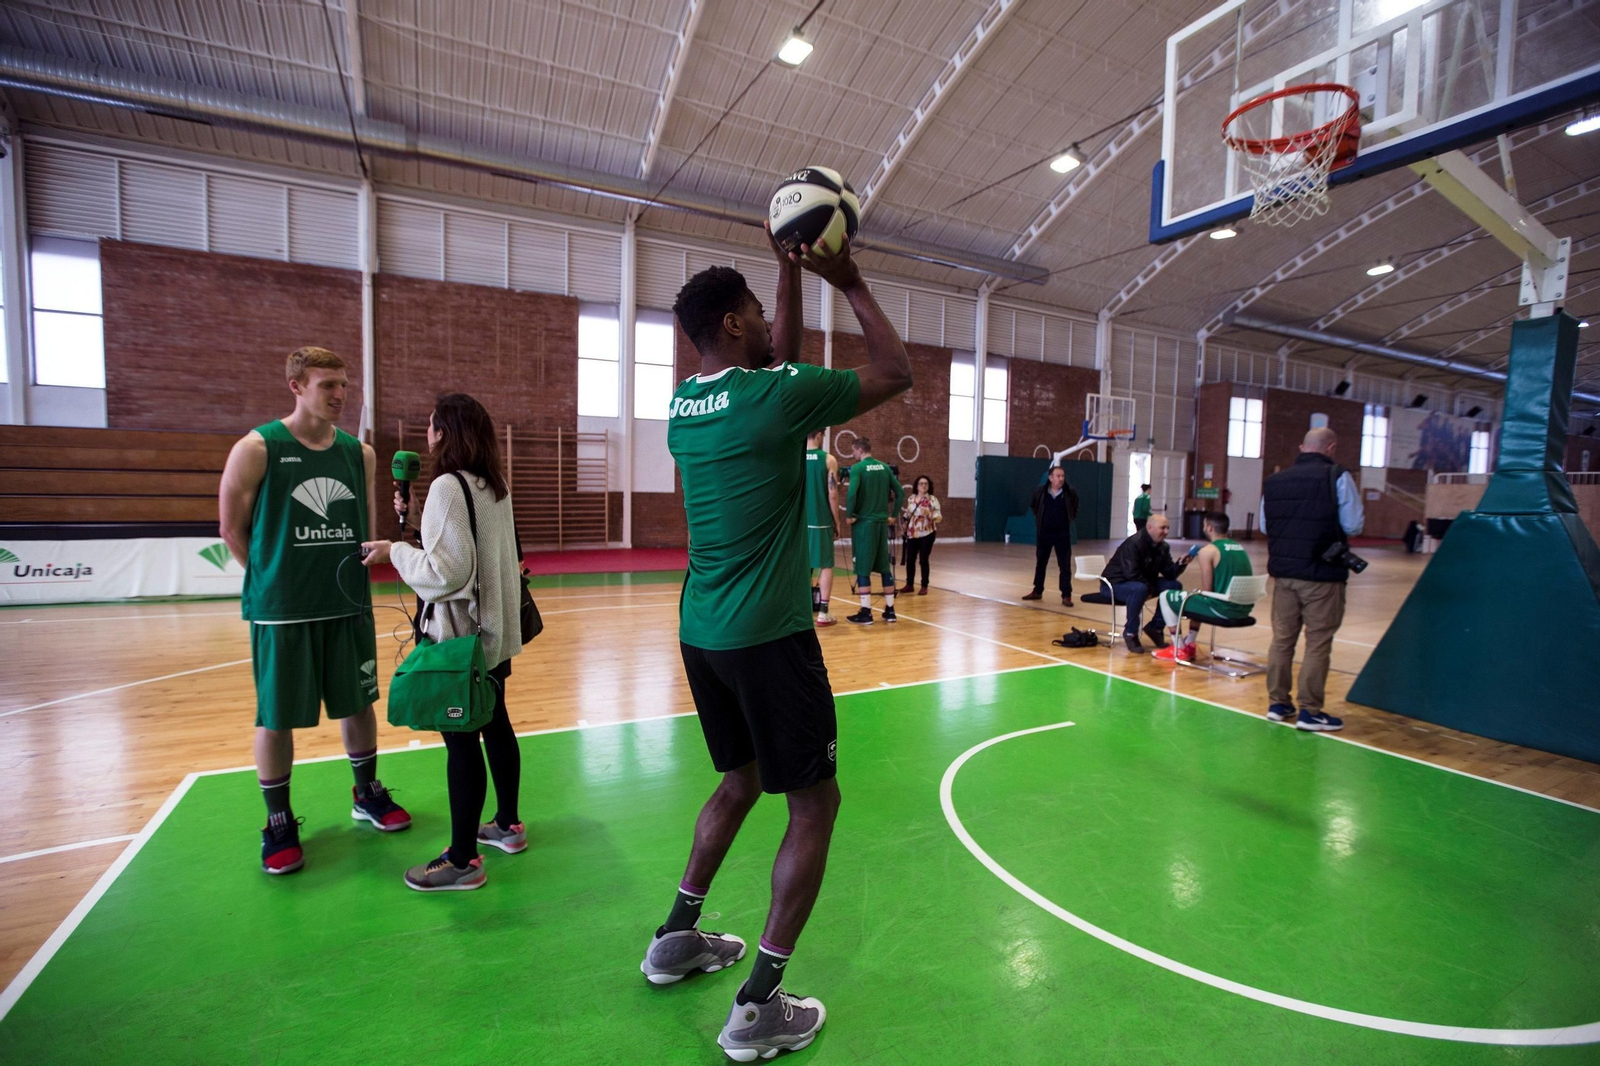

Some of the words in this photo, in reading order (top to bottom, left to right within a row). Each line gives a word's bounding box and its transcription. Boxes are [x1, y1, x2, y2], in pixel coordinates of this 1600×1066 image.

[670, 390, 730, 419] Joma
[294, 522, 355, 542] Unicaja
[13, 562, 94, 579] Unicaja
